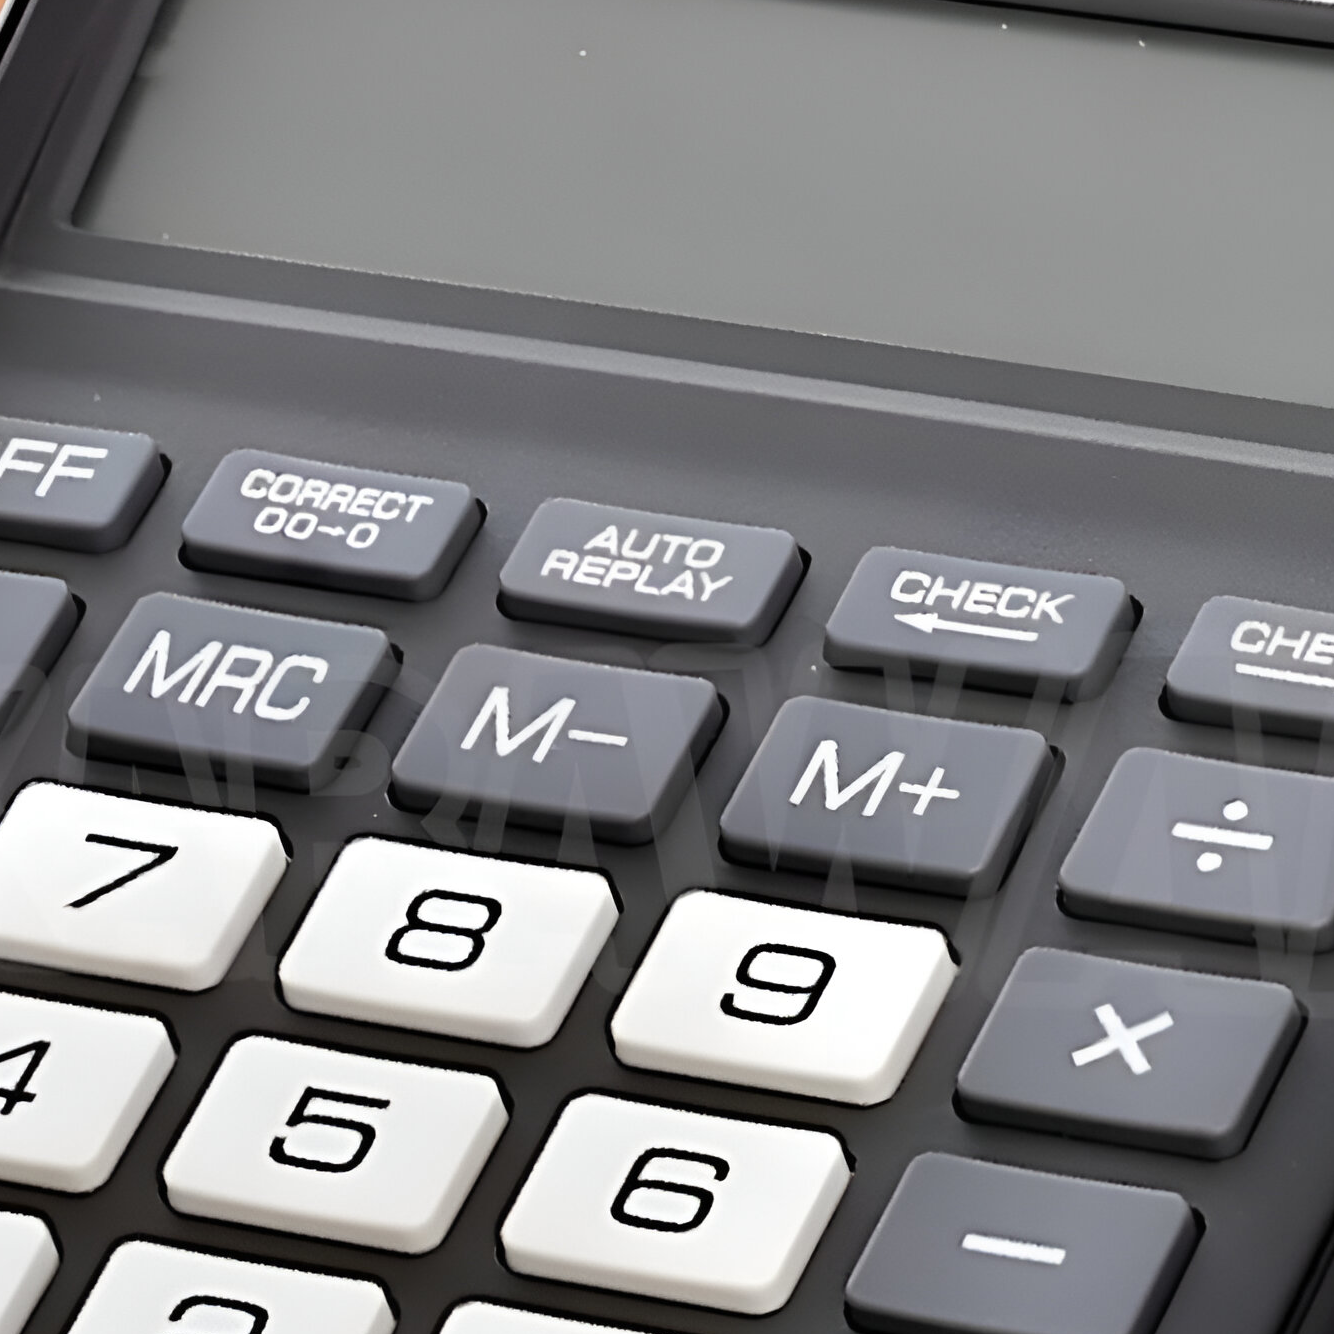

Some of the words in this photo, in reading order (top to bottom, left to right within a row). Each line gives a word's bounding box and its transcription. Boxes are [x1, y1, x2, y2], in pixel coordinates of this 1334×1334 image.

[240, 468, 434, 523] CORRECT
[540, 550, 734, 603] REPLAY
[581, 525, 726, 569] AUTO
[890, 570, 1076, 625] CHECK
[122, 630, 329, 722] MRC
[788, 739, 961, 817] M+
[65, 833, 179, 909] 7
[384, 888, 502, 972] 8
[719, 942, 837, 1026] 9
[268, 1085, 391, 1174] 5
[610, 1147, 730, 1234] 6
